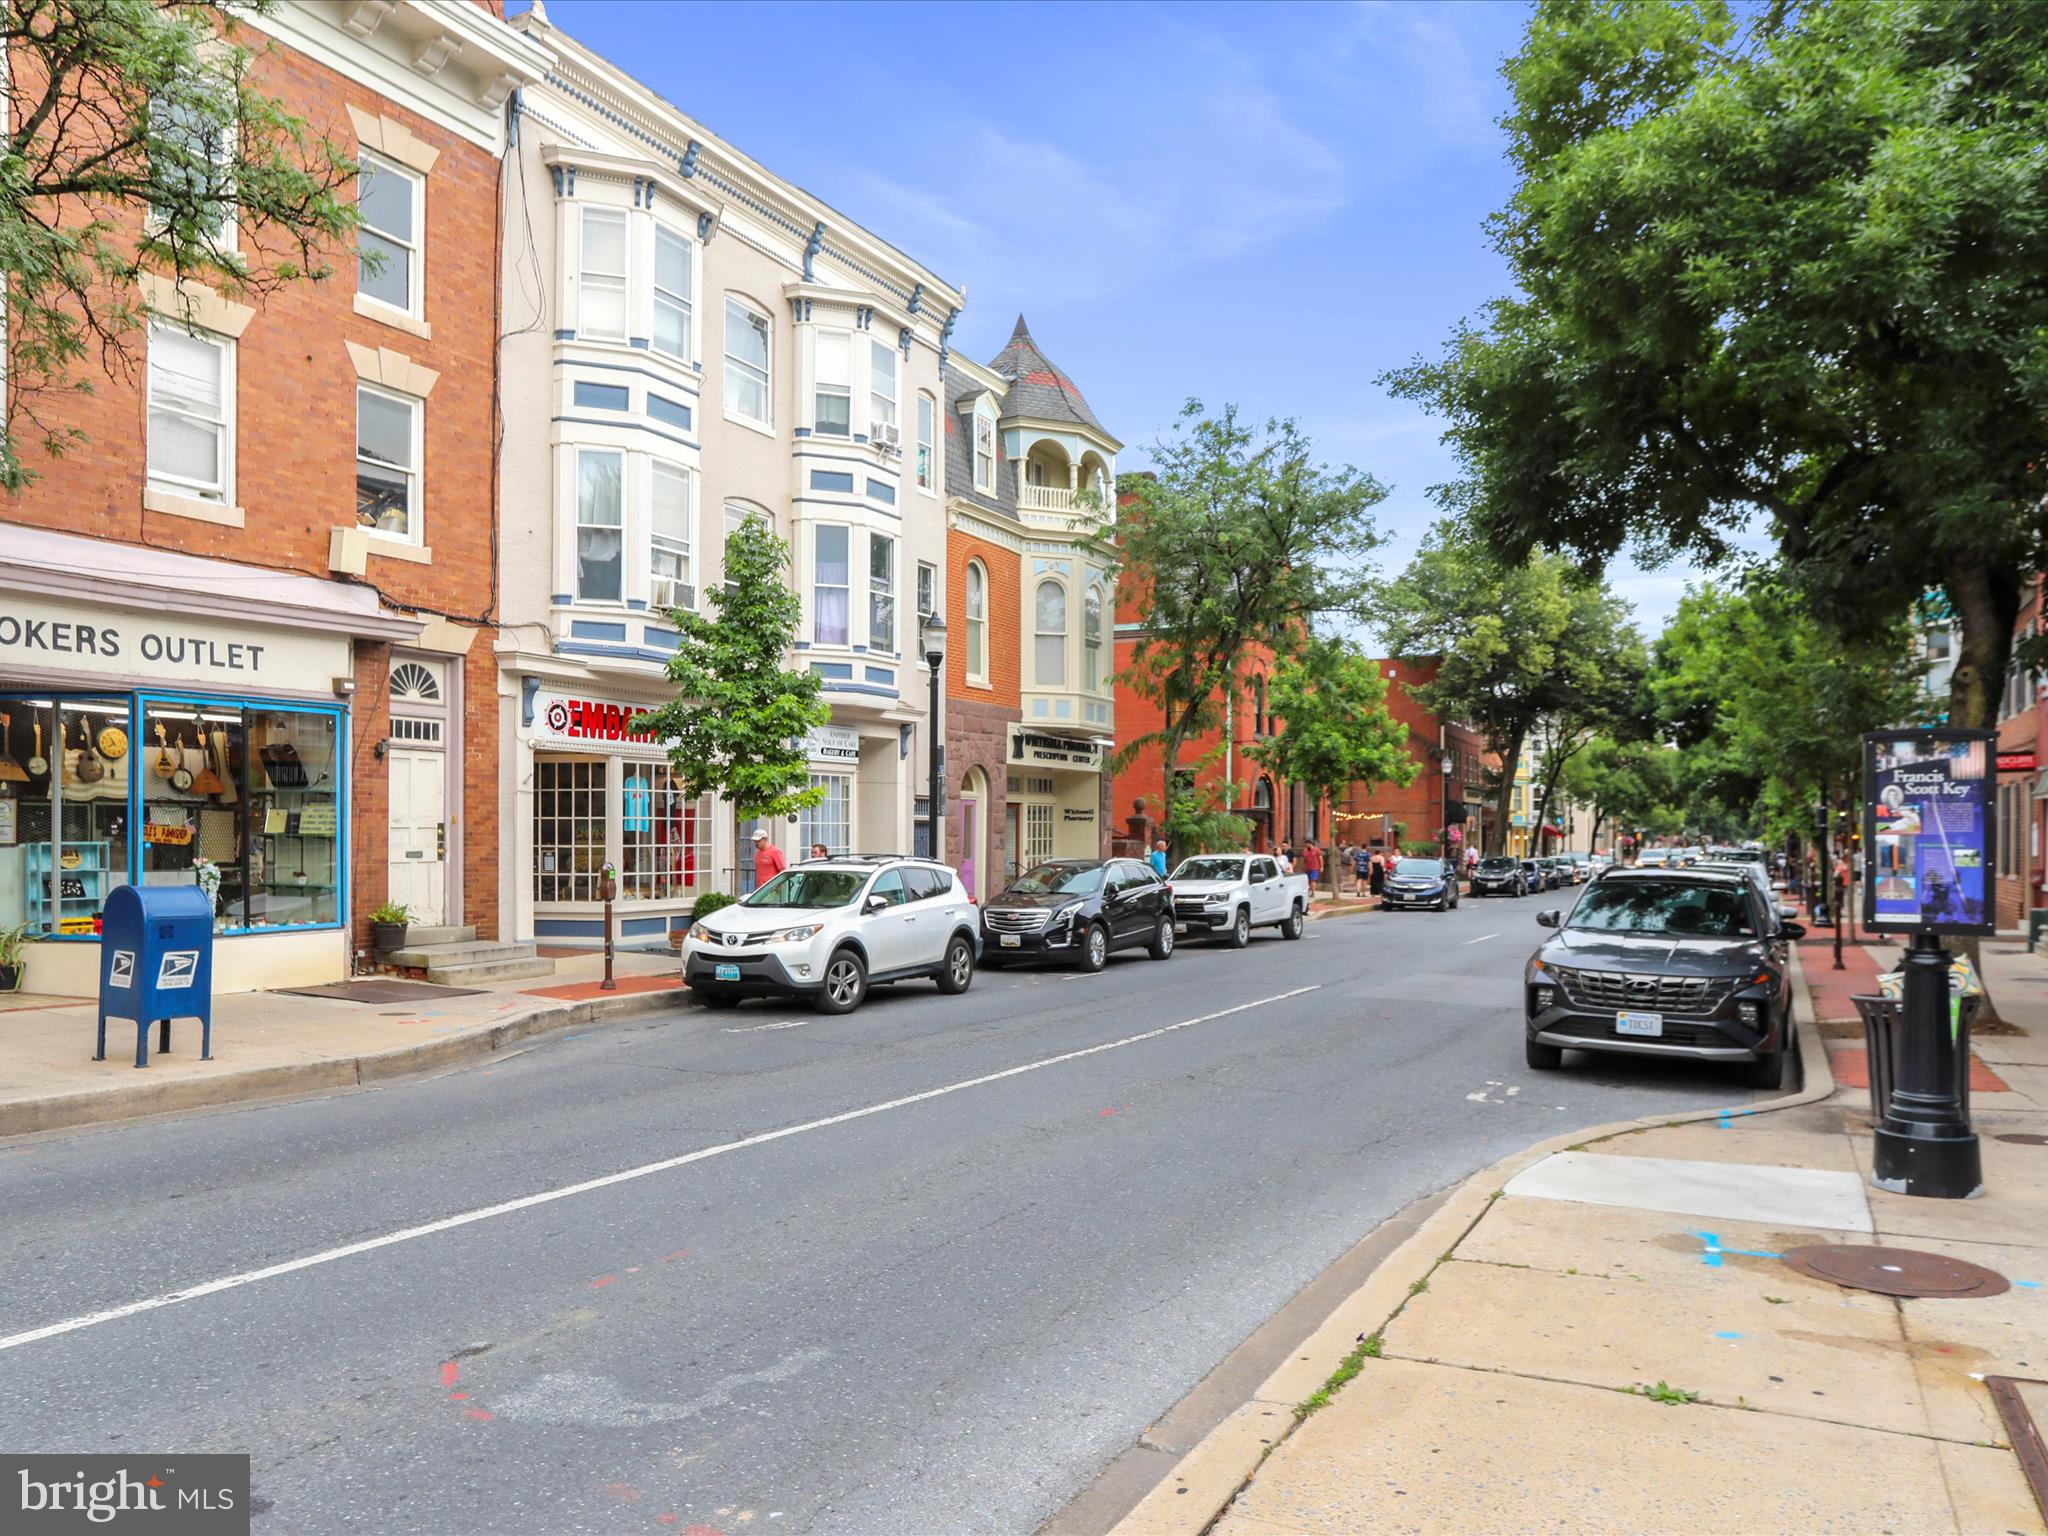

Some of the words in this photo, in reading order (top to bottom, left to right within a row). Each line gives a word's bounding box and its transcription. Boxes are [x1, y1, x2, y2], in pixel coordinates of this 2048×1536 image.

[0, 616, 120, 657] OKERS
[140, 633, 264, 671] OUTLET
[1034, 751, 1068, 761] PRESCRIPTION
[1072, 754, 1091, 764] CENTER
[1893, 769, 1945, 783] Francis
[1904, 782, 1940, 795] Scott
[1942, 782, 1971, 798] Key
[1063, 815, 1094, 823] Pharmacy
